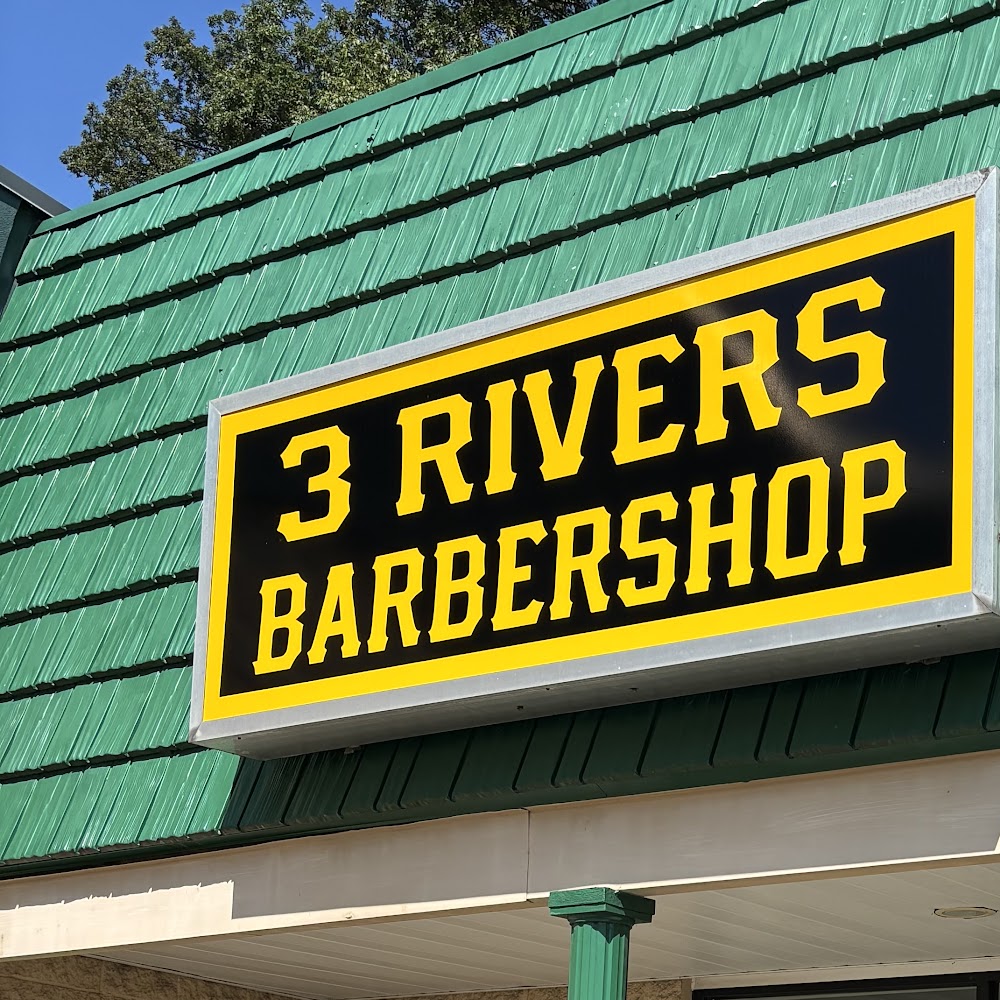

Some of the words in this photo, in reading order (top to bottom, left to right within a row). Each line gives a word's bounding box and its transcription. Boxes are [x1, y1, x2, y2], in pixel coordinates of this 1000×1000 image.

[277, 424, 352, 543] 3
[395, 275, 886, 516] RIVERS
[252, 439, 907, 675] BARBERSHOP
